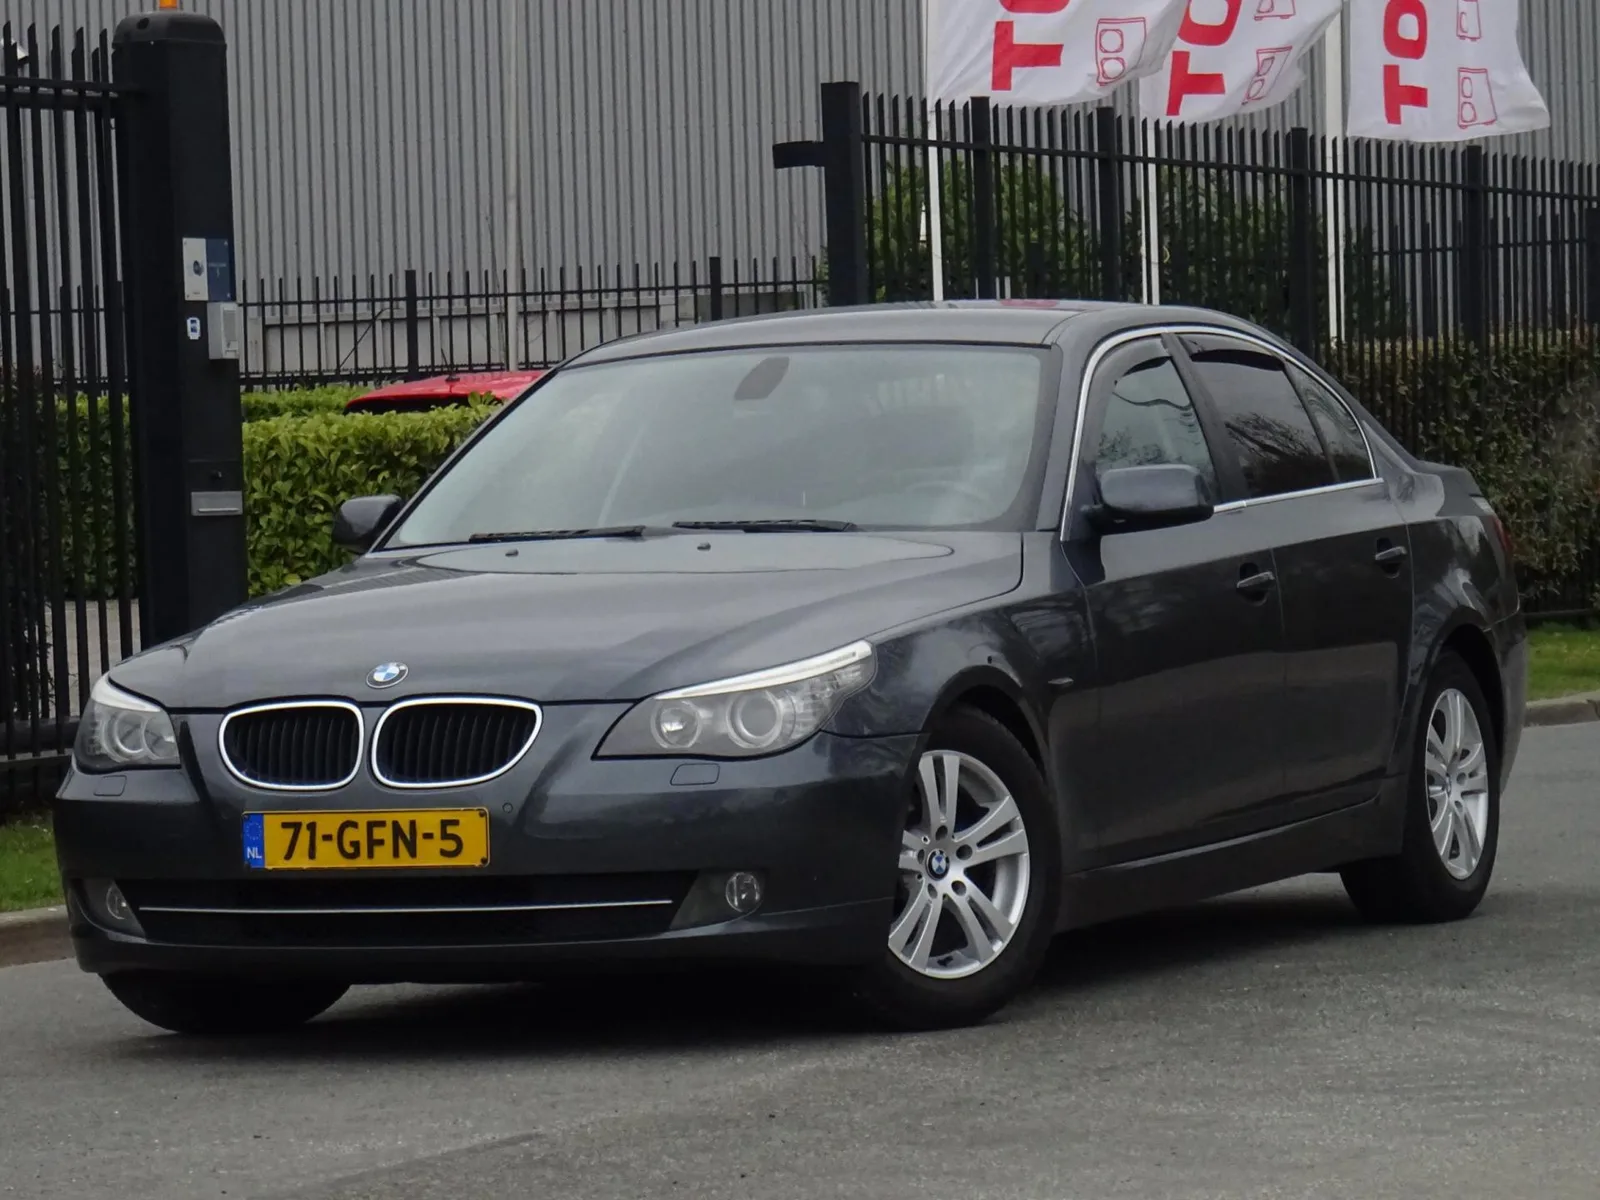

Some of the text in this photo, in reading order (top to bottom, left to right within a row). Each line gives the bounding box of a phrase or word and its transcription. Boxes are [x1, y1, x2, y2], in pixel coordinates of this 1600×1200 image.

[1383, 0, 1428, 125] TO
[246, 846, 262, 860] NL
[281, 819, 464, 861] 71-GFN-5
